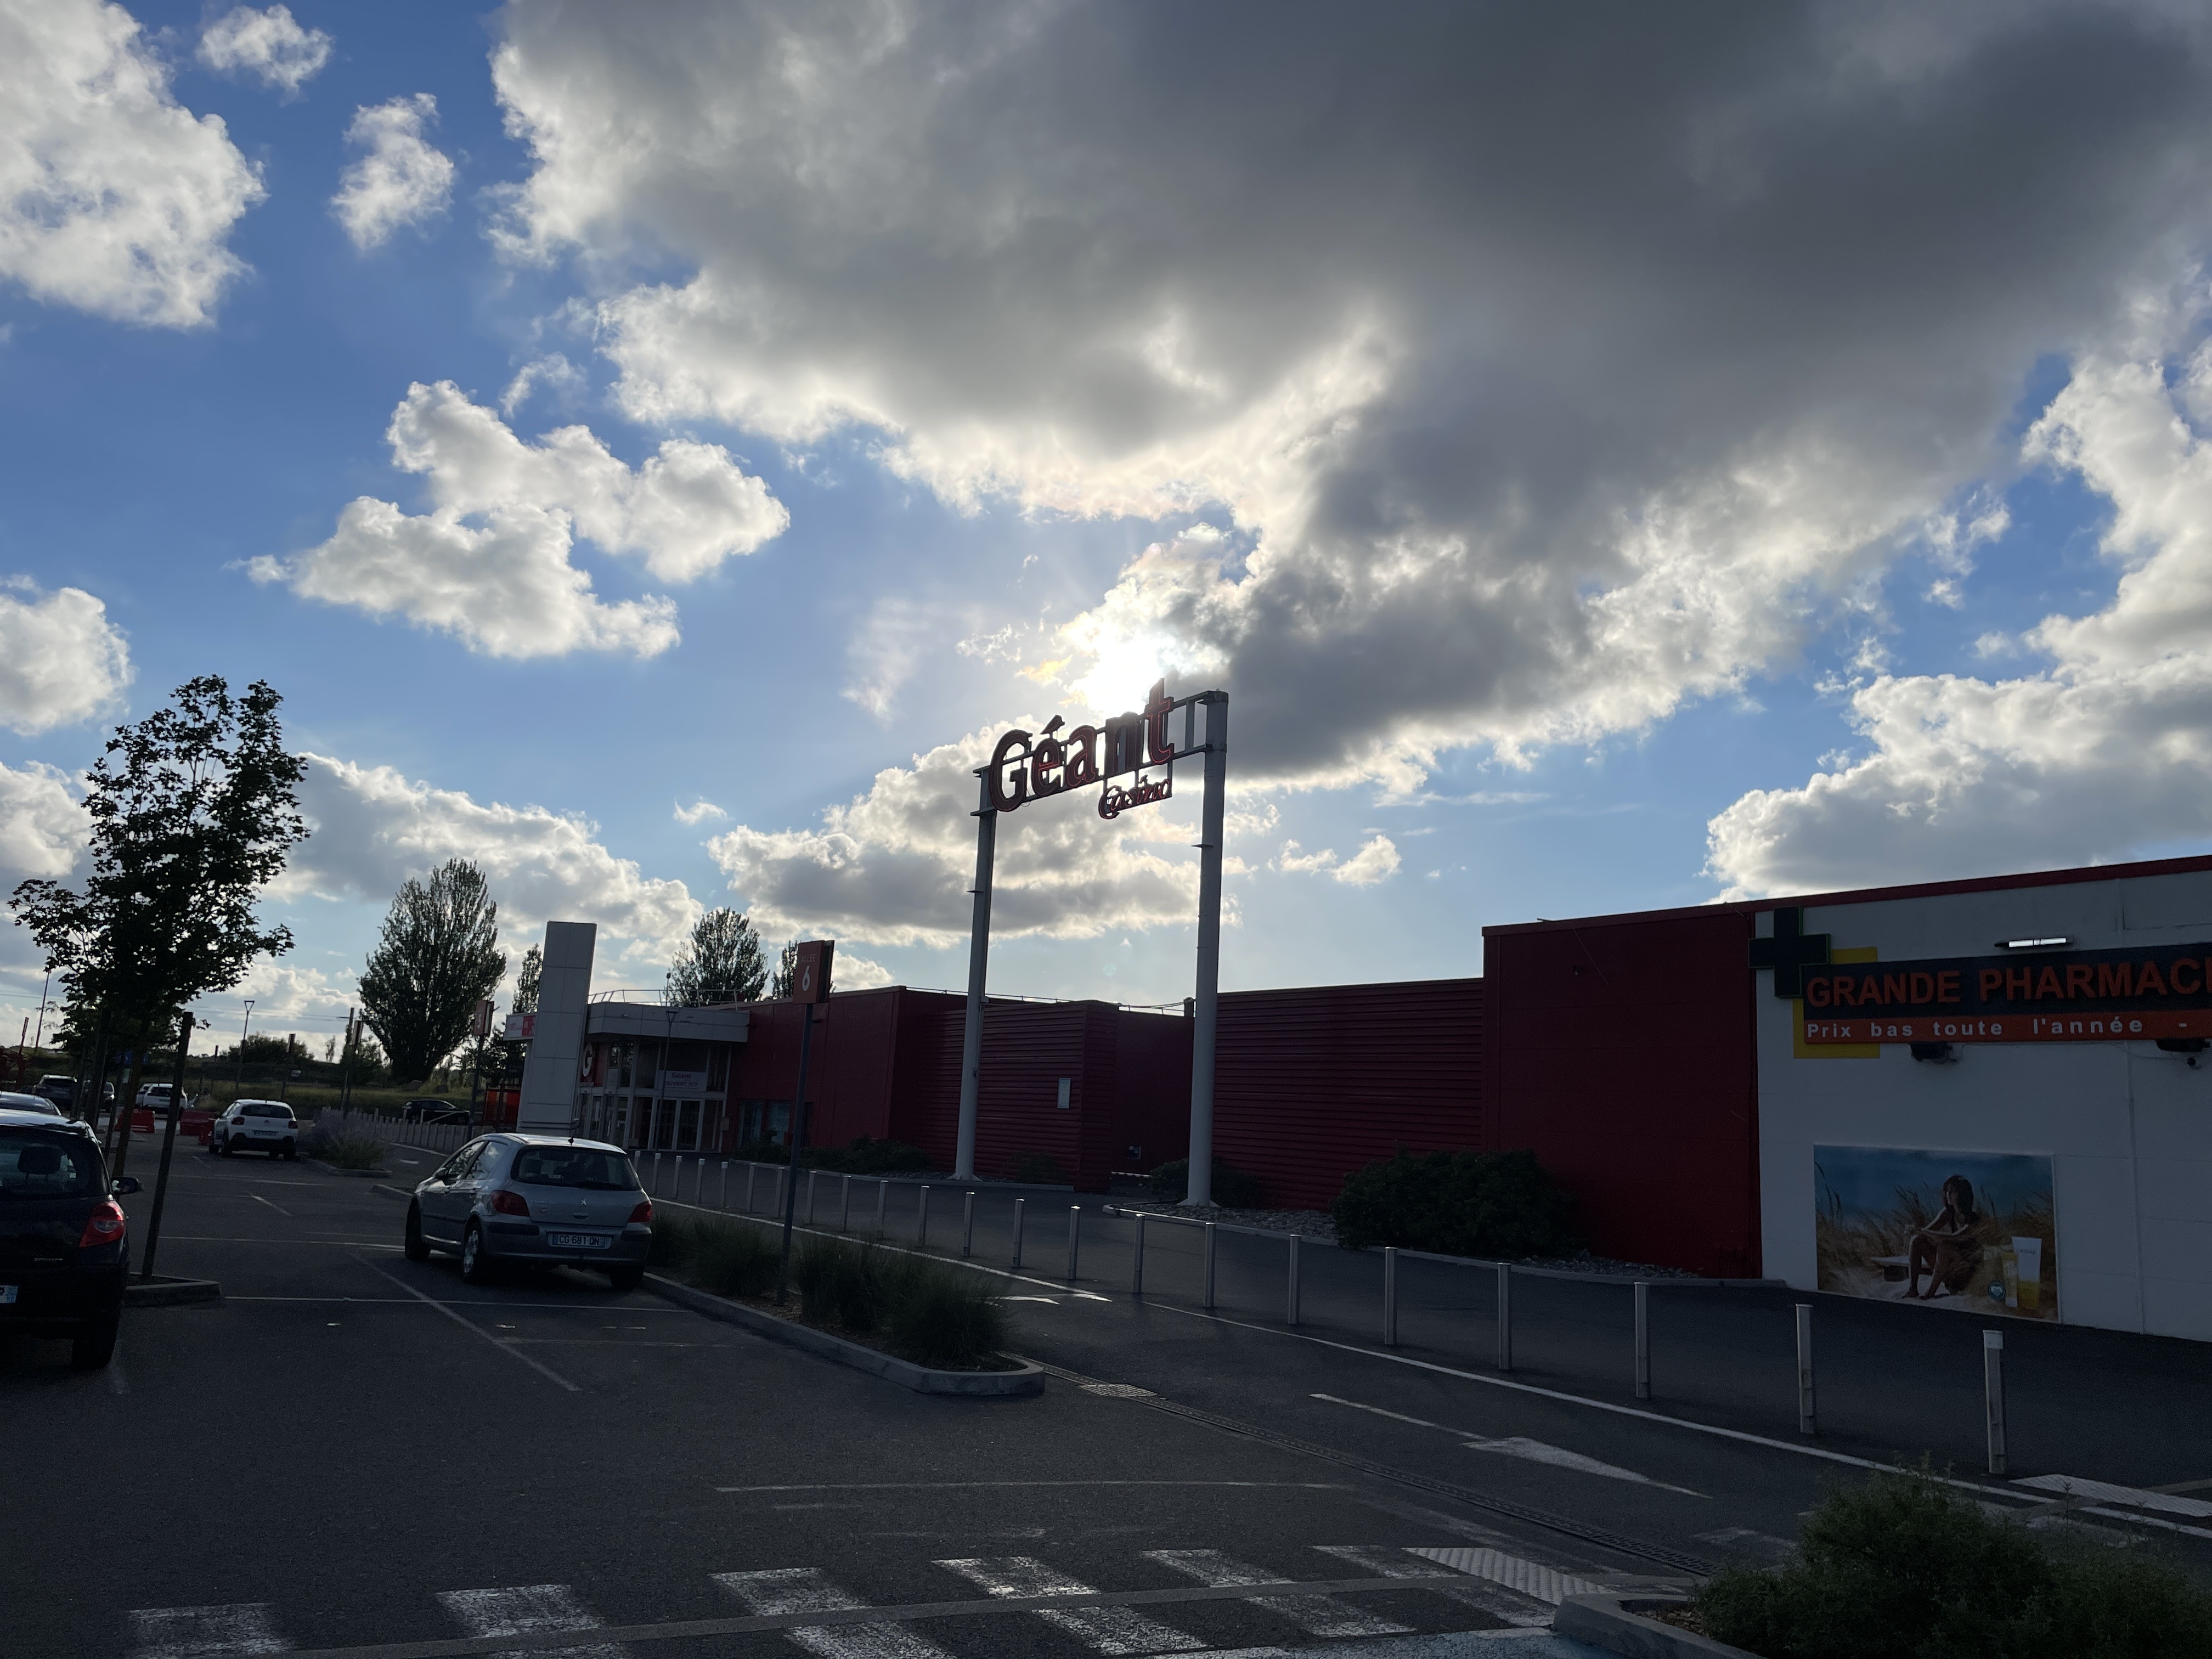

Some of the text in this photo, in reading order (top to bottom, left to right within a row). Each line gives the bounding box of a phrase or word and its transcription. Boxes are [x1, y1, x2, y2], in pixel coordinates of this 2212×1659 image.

[990, 678, 1174, 812] Géant
[1098, 774, 1172, 819] Casino
[802, 966, 810, 992] 6
[1807, 969, 1962, 1008] GRANDE
[1807, 1023, 1852, 1037] Prix
[1871, 1022, 1914, 1037] bas
[1933, 1020, 2002, 1036] toute
[2033, 1016, 2142, 1035] l'année
